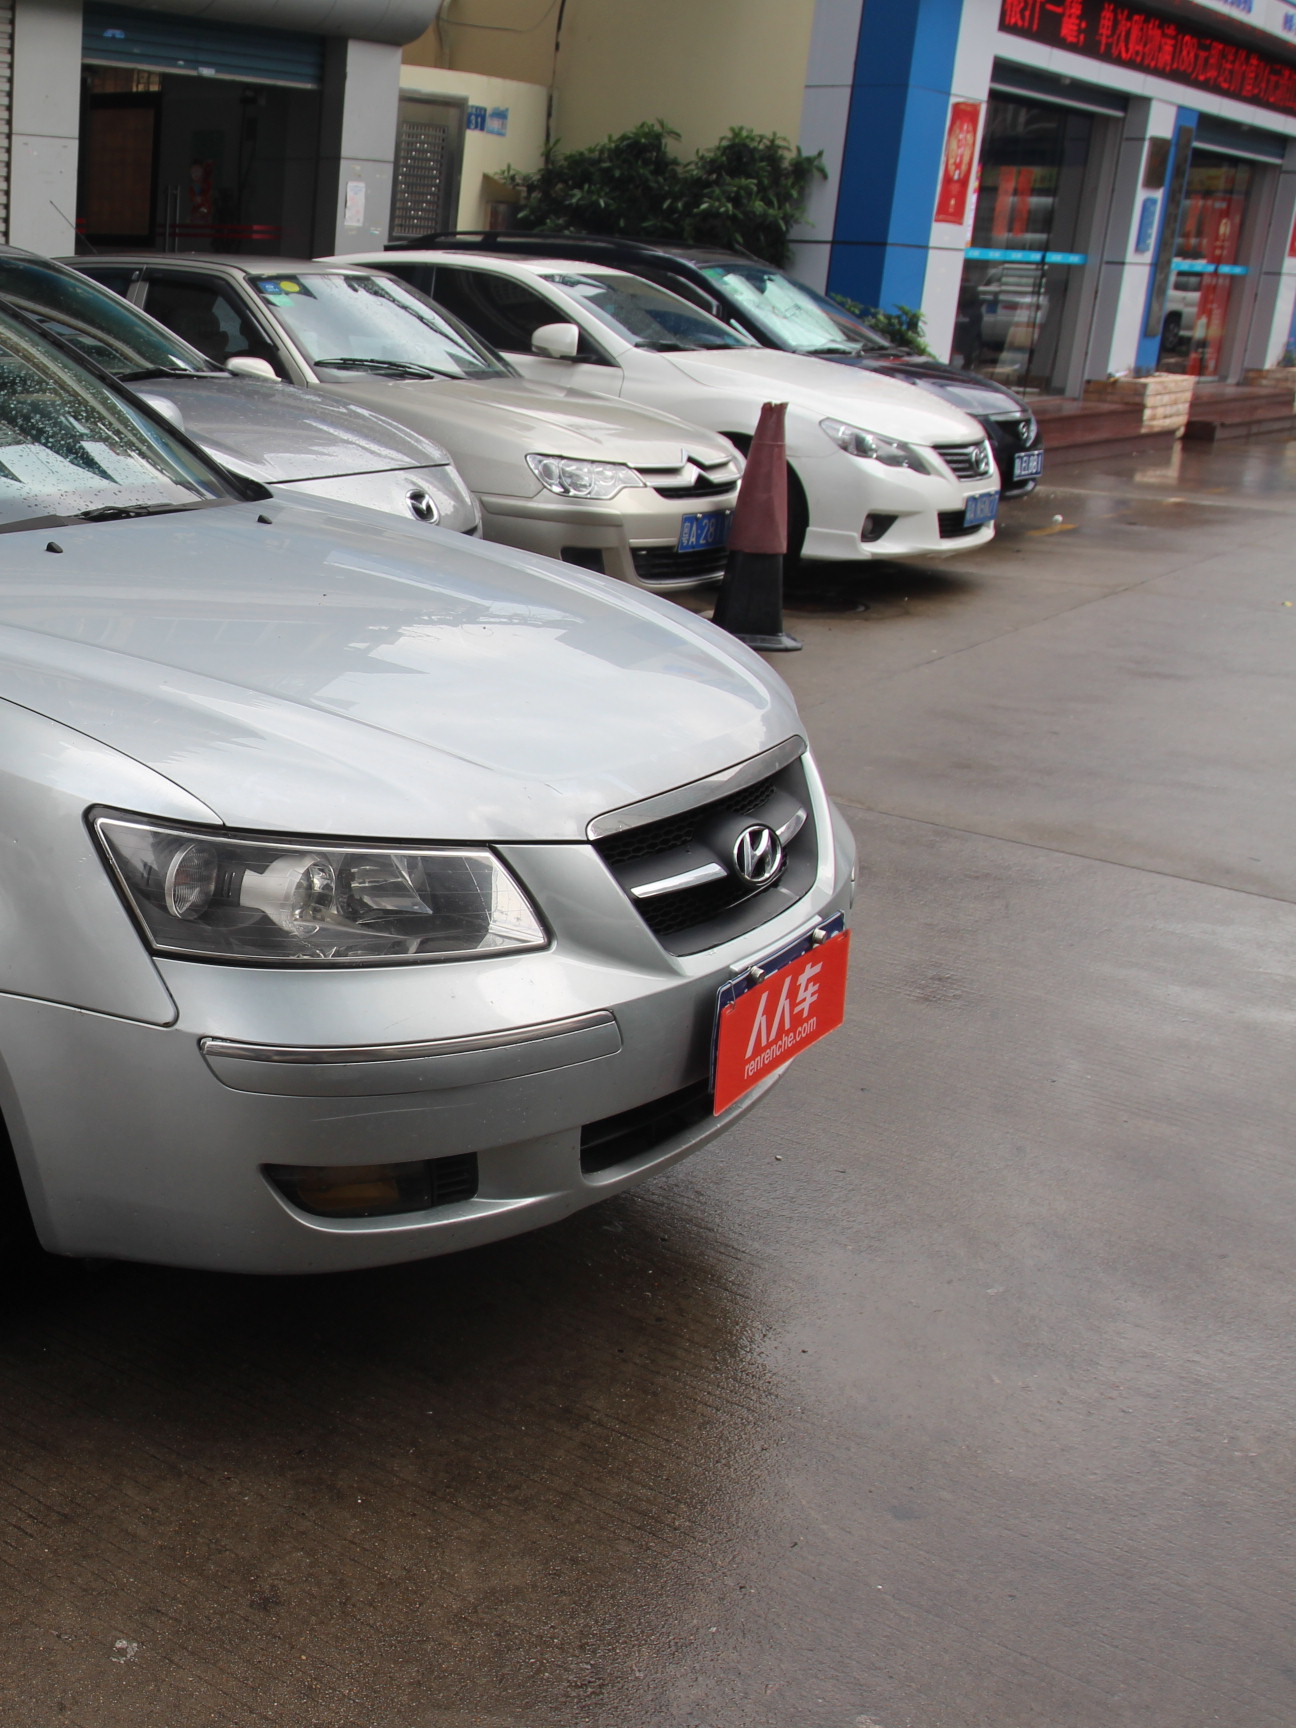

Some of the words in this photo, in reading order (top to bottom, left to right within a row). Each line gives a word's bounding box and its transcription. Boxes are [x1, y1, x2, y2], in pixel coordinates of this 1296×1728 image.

[744, 1016, 817, 1080] renrenche.com
[745, 962, 824, 1060] 人人车
